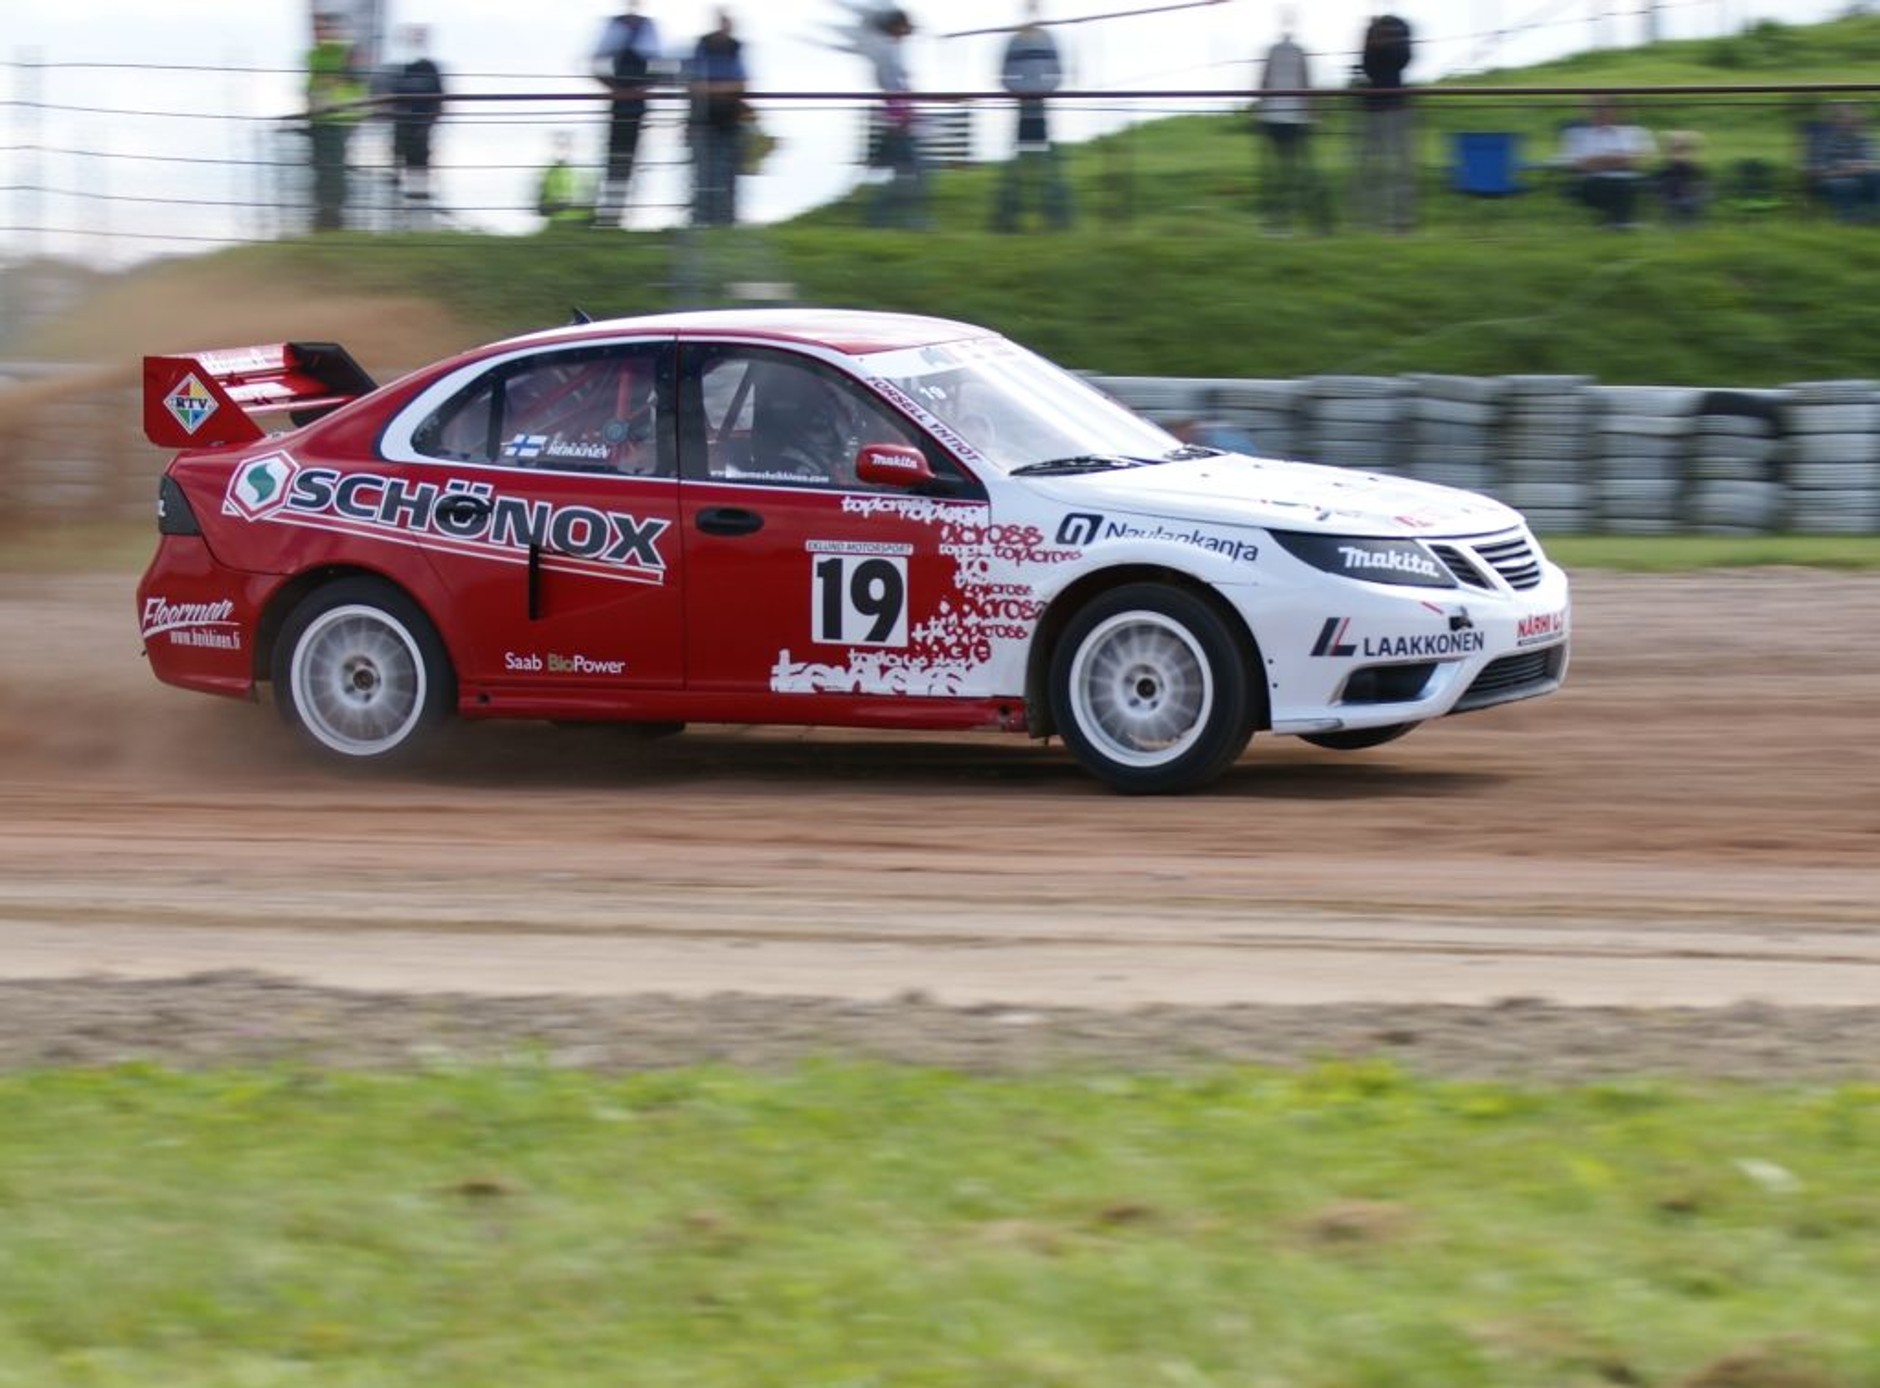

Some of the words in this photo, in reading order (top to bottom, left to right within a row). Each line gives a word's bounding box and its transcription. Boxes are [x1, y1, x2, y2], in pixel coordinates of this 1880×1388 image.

[176, 396, 208, 409] RTV
[288, 468, 671, 569] SCHÖNOX
[143, 597, 234, 630] Floorman
[816, 558, 904, 643] 19
[1363, 630, 1484, 658] LAAKKONEN
[505, 652, 543, 671] Saab
[548, 653, 626, 674] BioPower
